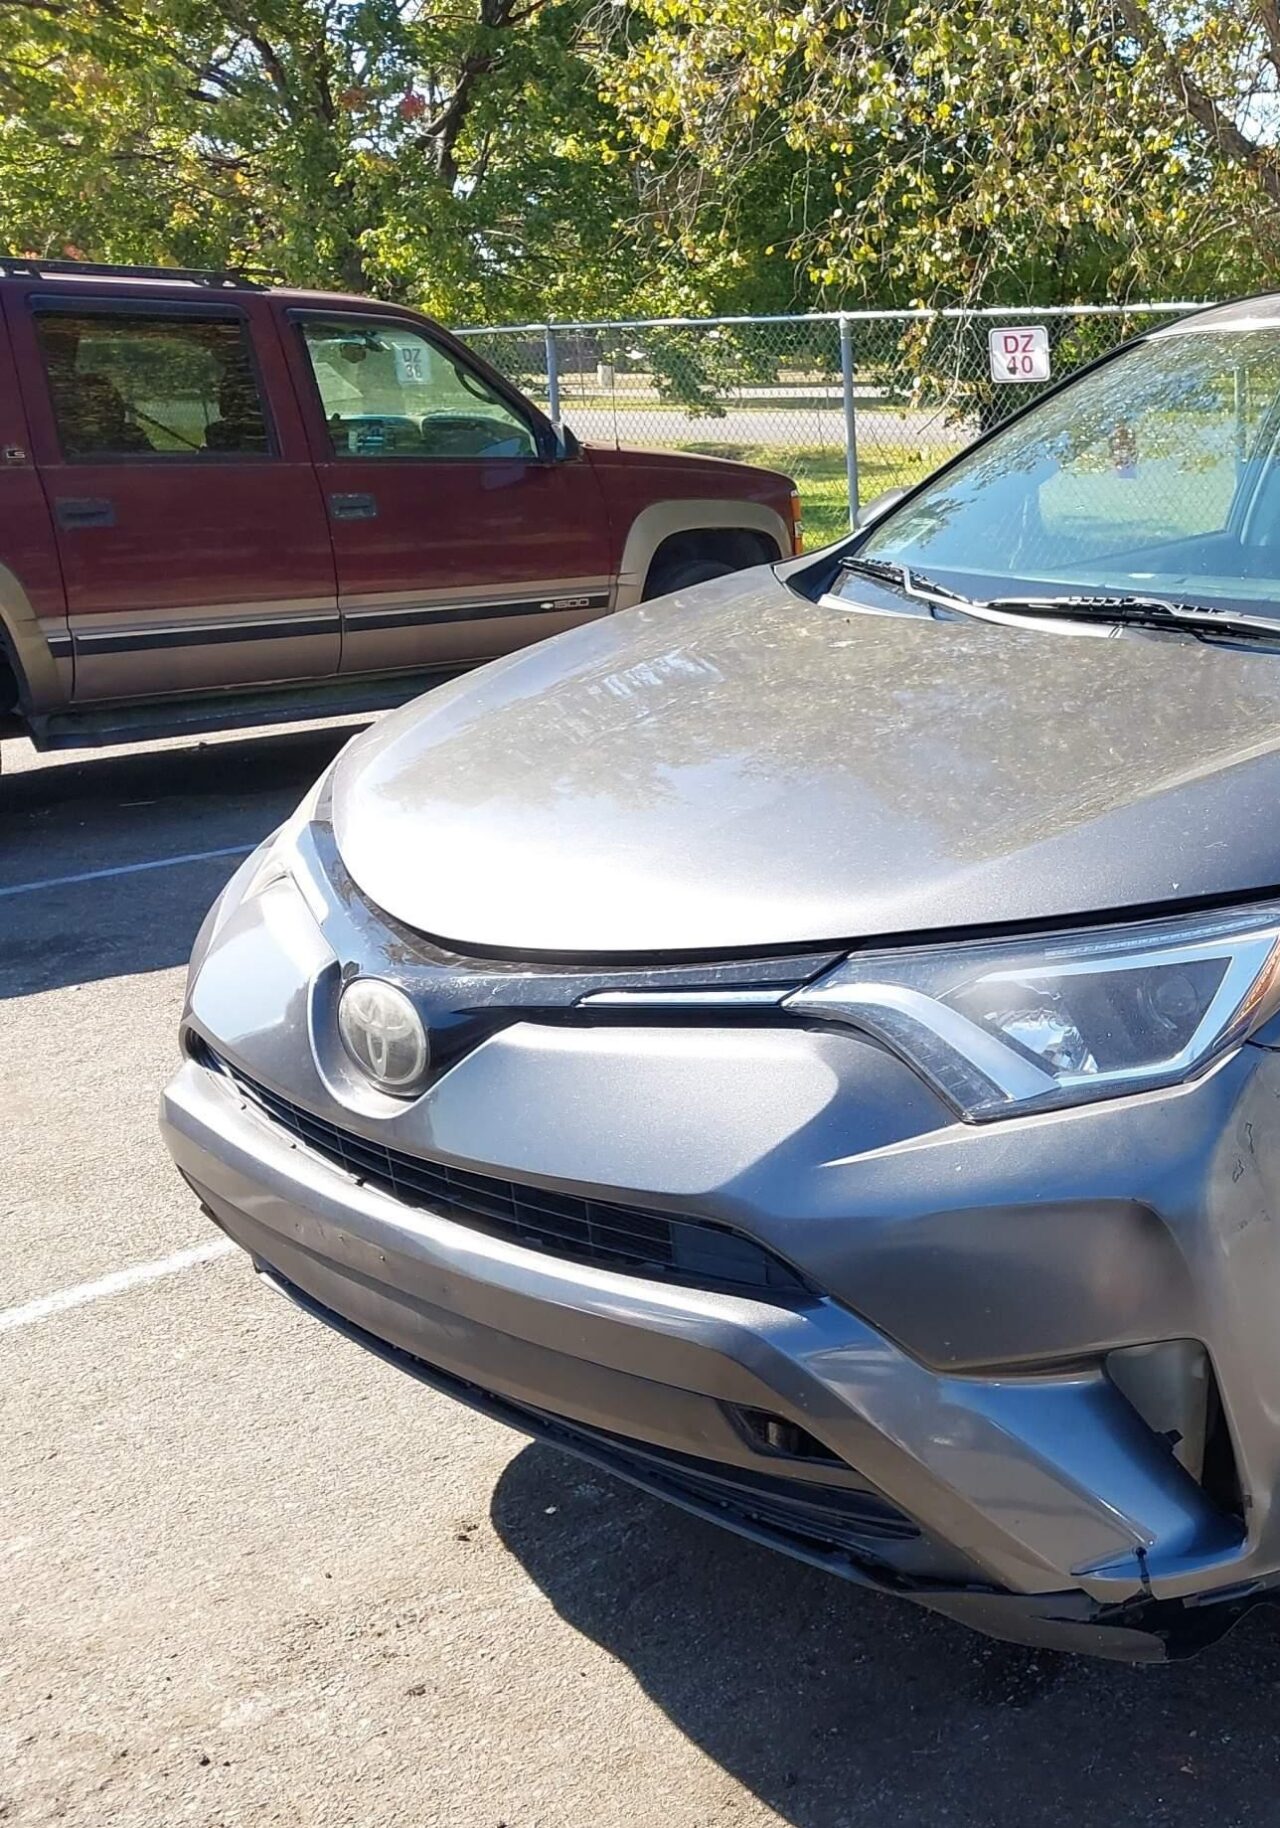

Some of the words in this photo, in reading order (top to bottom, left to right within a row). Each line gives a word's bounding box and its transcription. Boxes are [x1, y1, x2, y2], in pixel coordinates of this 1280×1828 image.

[1004, 334, 1034, 353] DZ
[402, 348, 421, 362] DZ
[1006, 355, 1033, 375] 40
